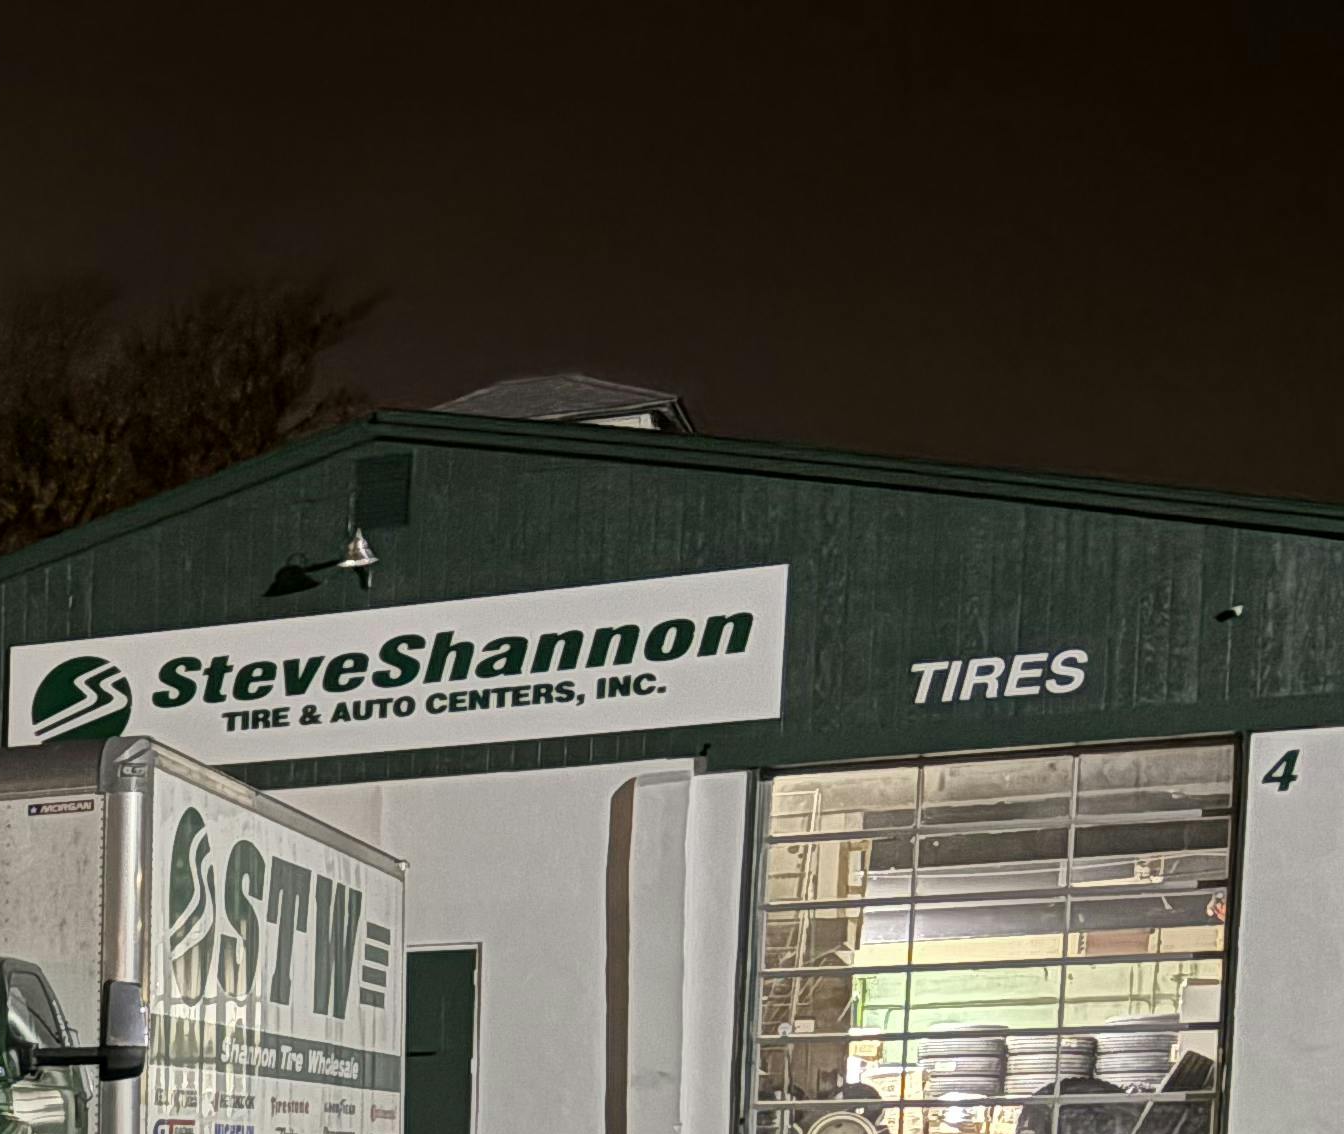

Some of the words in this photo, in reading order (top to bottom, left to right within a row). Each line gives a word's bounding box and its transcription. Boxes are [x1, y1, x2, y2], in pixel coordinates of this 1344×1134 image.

[910, 649, 1089, 704] TIRES
[221, 706, 290, 732] TIRE
[298, 703, 323, 726] &
[330, 695, 416, 724] AUTO
[425, 681, 586, 715] CENTERS,
[596, 673, 667, 700] INC.
[1262, 749, 1300, 792] 4
[39, 801, 92, 814] MORGAN
[217, 839, 362, 1020] STW
[221, 1037, 276, 1070] Shannon
[280, 1045, 304, 1073] Tire
[308, 1049, 360, 1080] Wholesale
